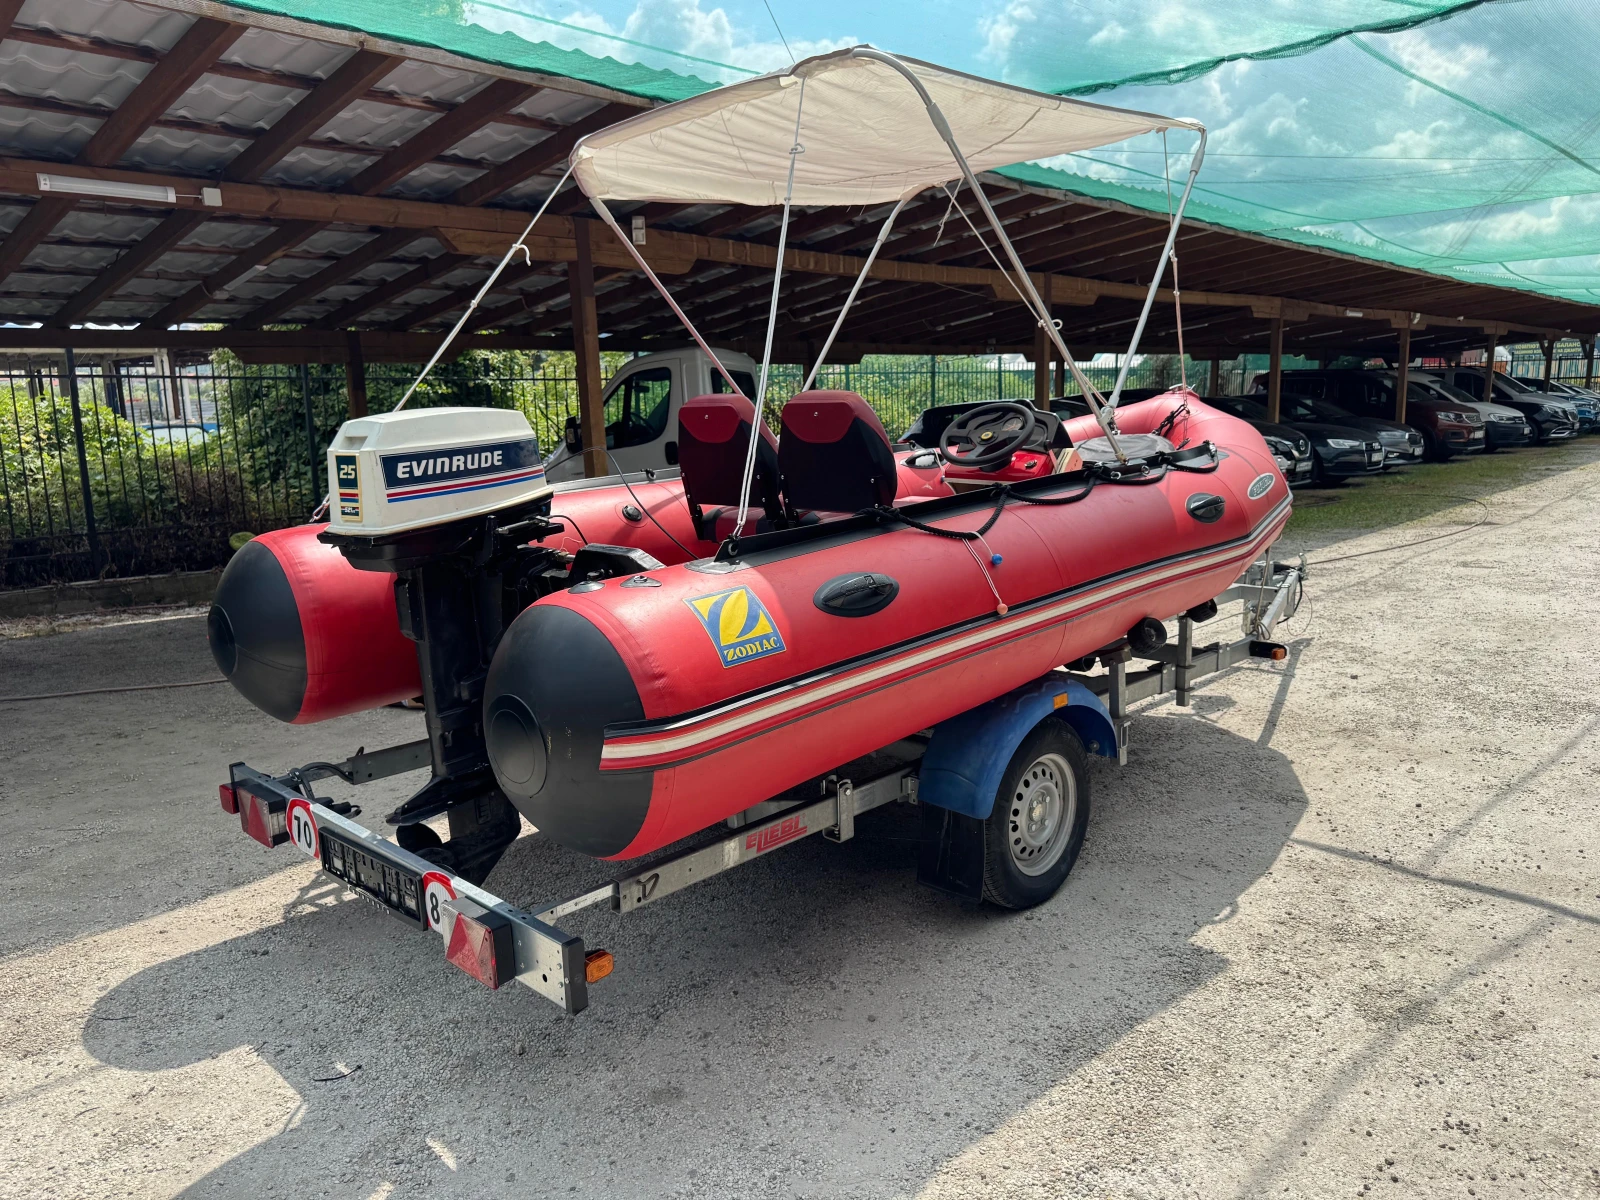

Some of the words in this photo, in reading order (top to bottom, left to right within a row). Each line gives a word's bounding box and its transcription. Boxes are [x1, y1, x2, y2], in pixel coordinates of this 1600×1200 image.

[339, 465, 356, 479] 25
[397, 450, 503, 479] EVINRUDE
[723, 636, 780, 662] ZODIAC
[294, 814, 312, 849] 70
[745, 814, 808, 855] ELLEBI
